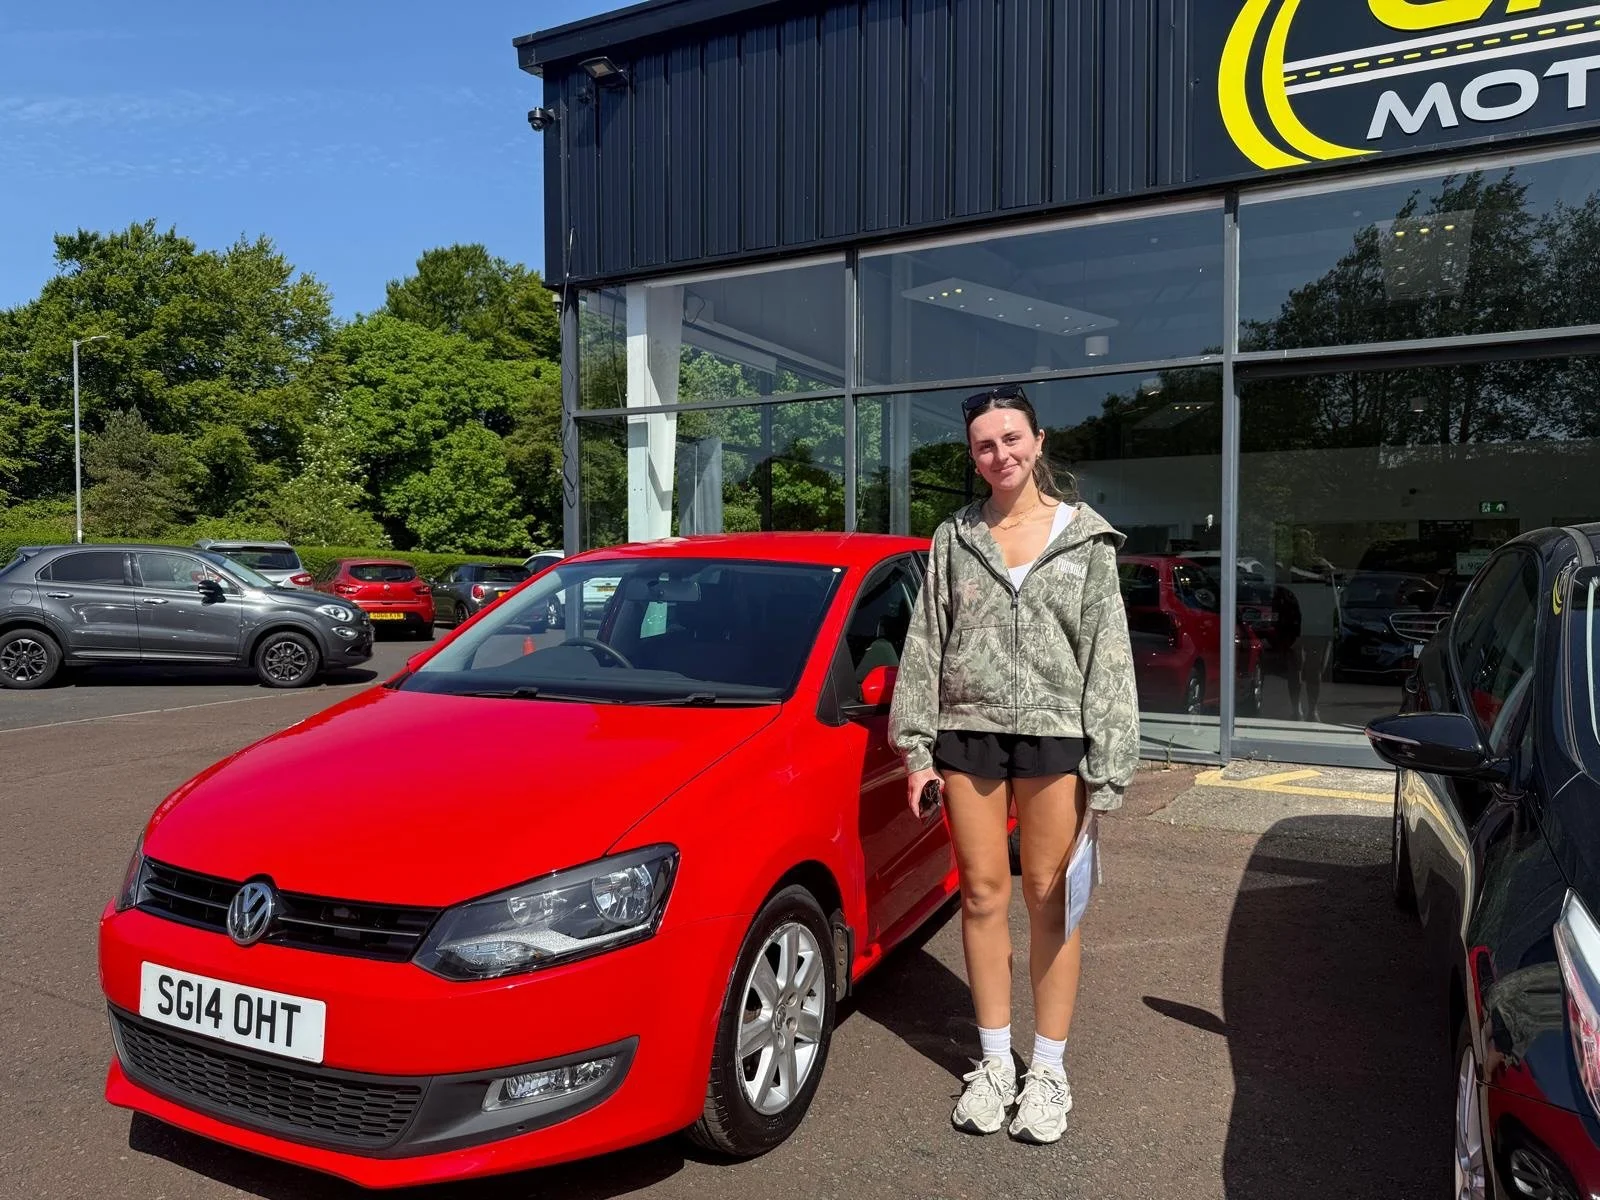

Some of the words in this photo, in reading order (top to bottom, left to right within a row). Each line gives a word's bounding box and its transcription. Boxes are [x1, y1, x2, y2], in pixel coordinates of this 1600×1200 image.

[1366, 55, 1600, 140] MOT
[157, 974, 223, 1029] SG14
[233, 992, 301, 1047] OHT
